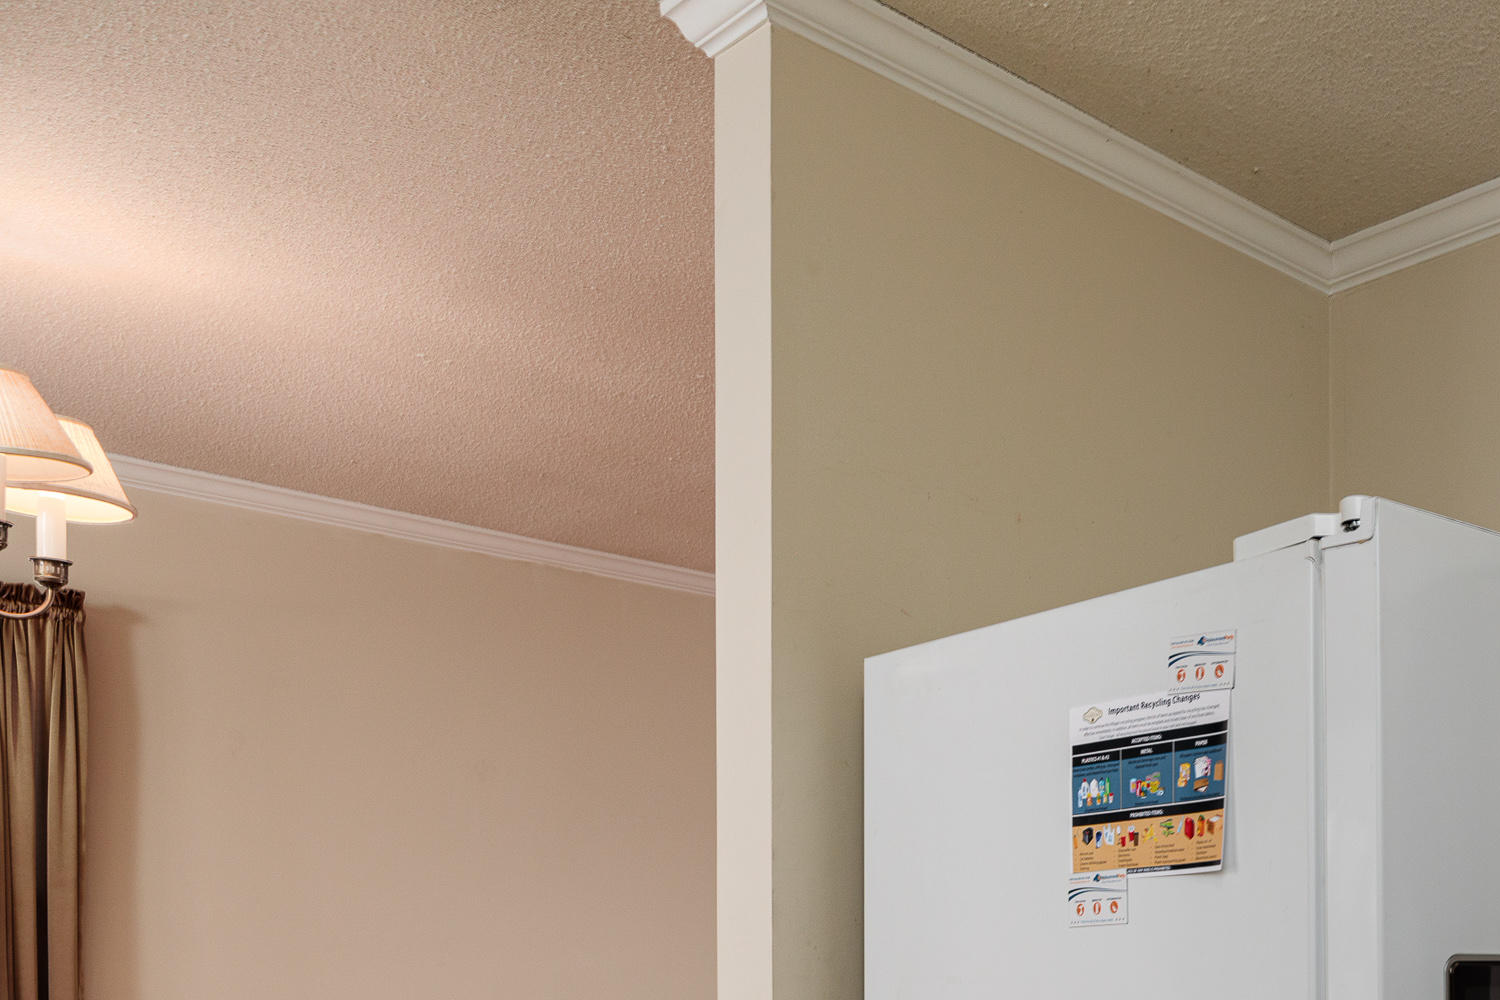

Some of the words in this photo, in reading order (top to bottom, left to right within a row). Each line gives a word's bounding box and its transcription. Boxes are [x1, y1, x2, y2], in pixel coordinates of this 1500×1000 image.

[1108, 703, 1139, 716] Important
[1140, 697, 1171, 709] Recycling
[1172, 693, 1200, 704] Changes
